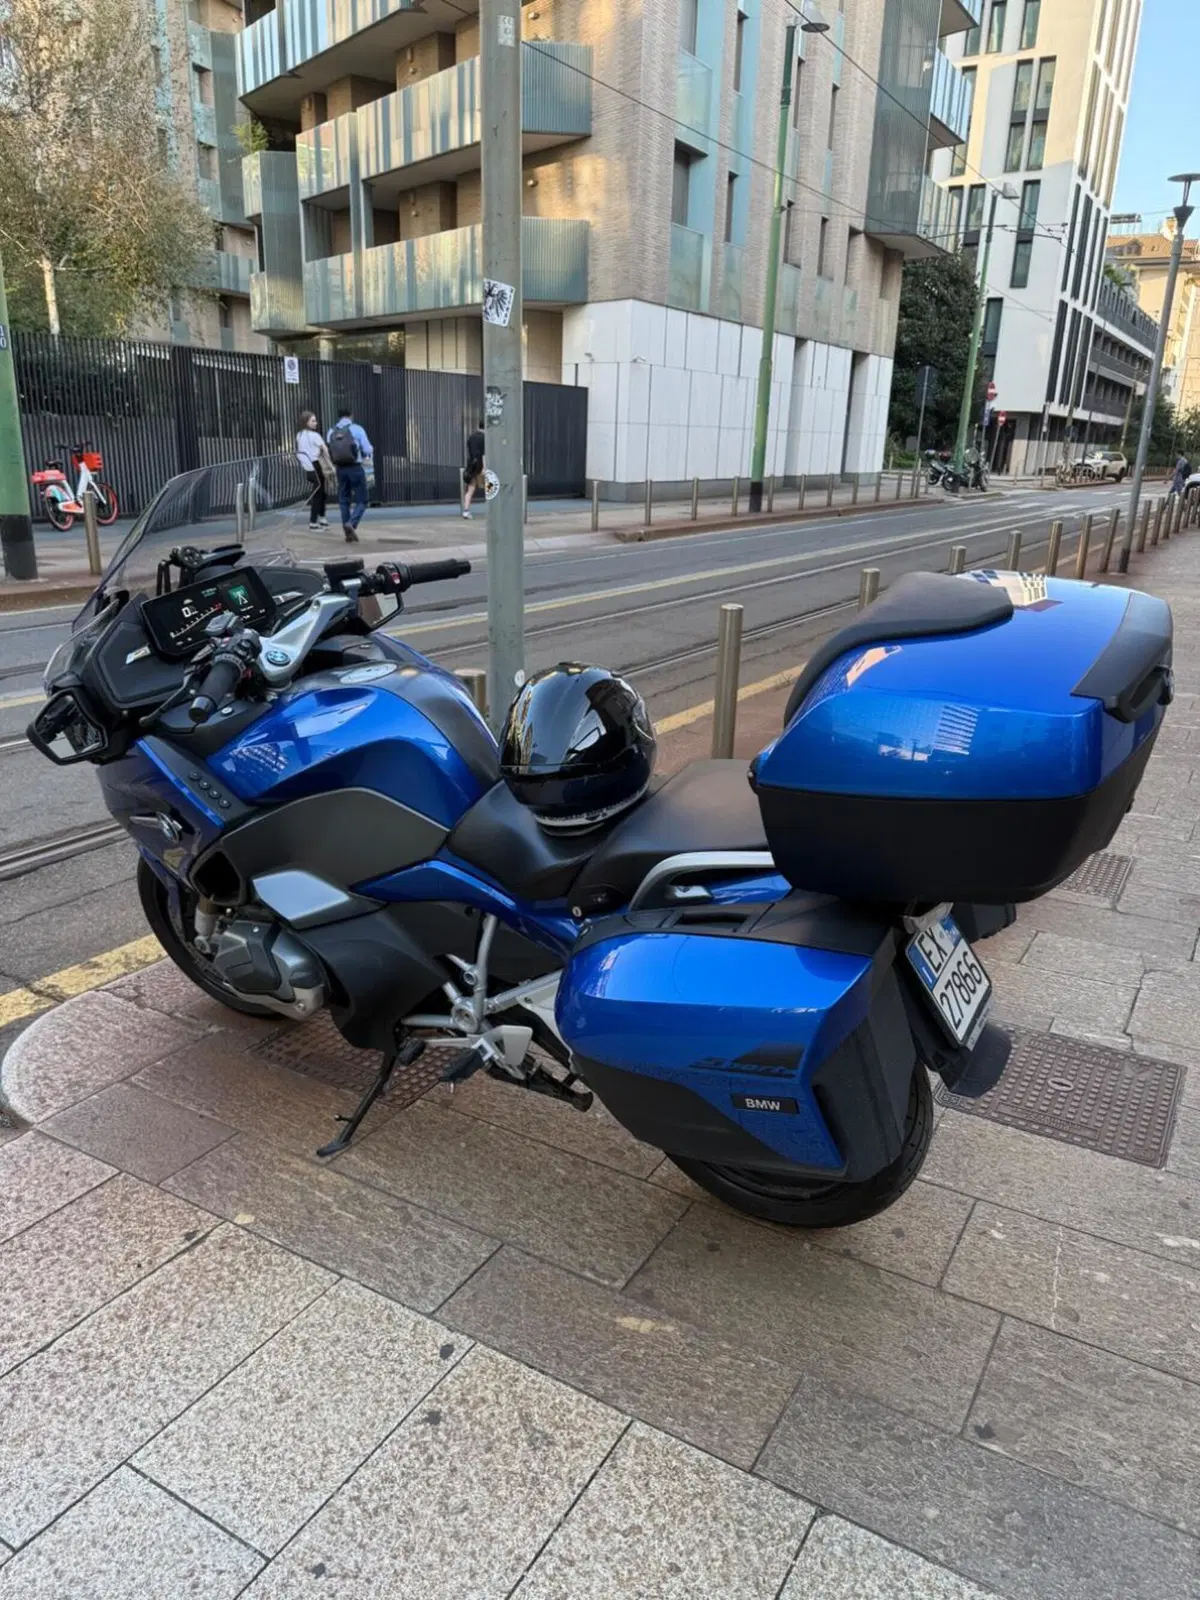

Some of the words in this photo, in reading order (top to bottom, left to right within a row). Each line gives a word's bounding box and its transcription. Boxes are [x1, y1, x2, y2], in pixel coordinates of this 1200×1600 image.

[917, 927, 948, 973] EX
[939, 951, 983, 1030] 27866
[745, 1098, 781, 1111] BMW
